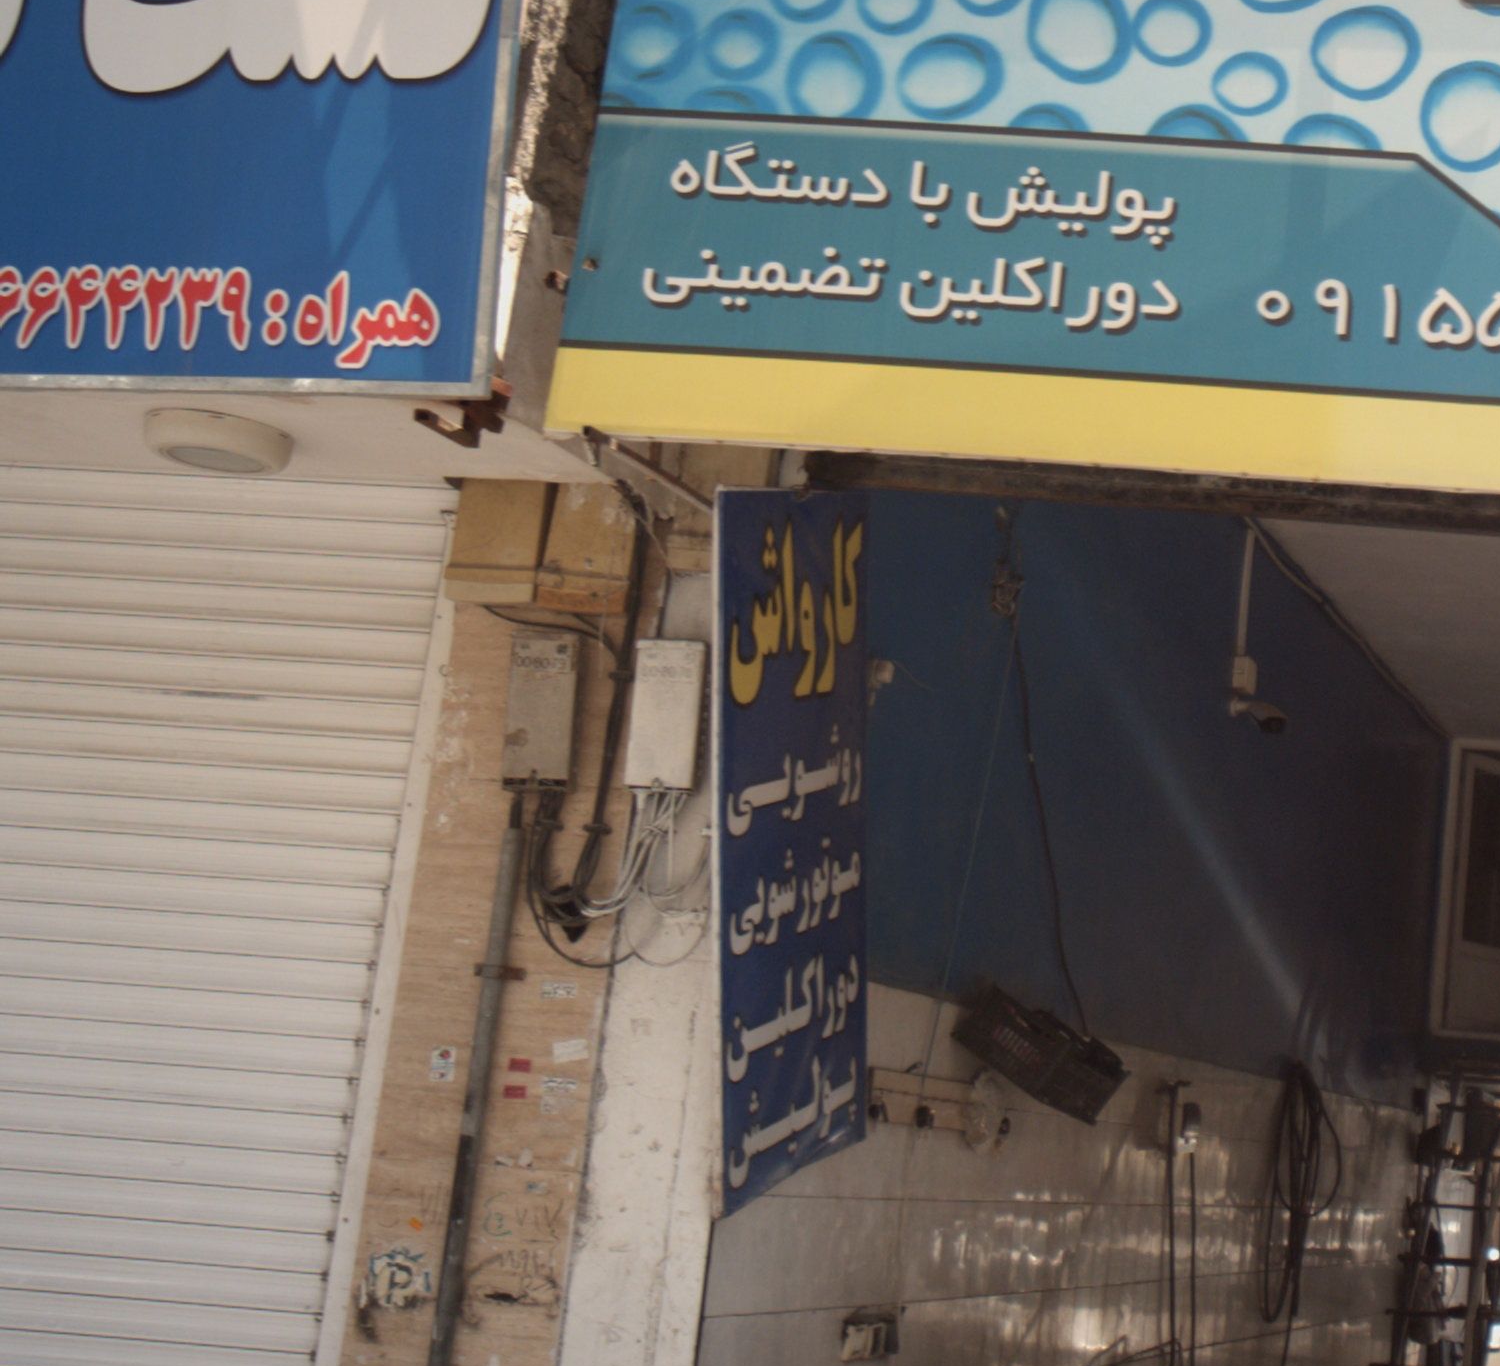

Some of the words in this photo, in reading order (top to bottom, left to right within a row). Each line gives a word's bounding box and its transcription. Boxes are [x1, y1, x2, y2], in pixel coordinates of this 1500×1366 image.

[670, 141, 889, 205] دستگاه
[910, 160, 949, 223] با
[965, 166, 1177, 246] پولیش
[642, 247, 887, 308] تضمینی
[729, 520, 863, 705] کارواش
[727, 723, 862, 836] روشویی
[728, 1054, 858, 1189] پولیش
